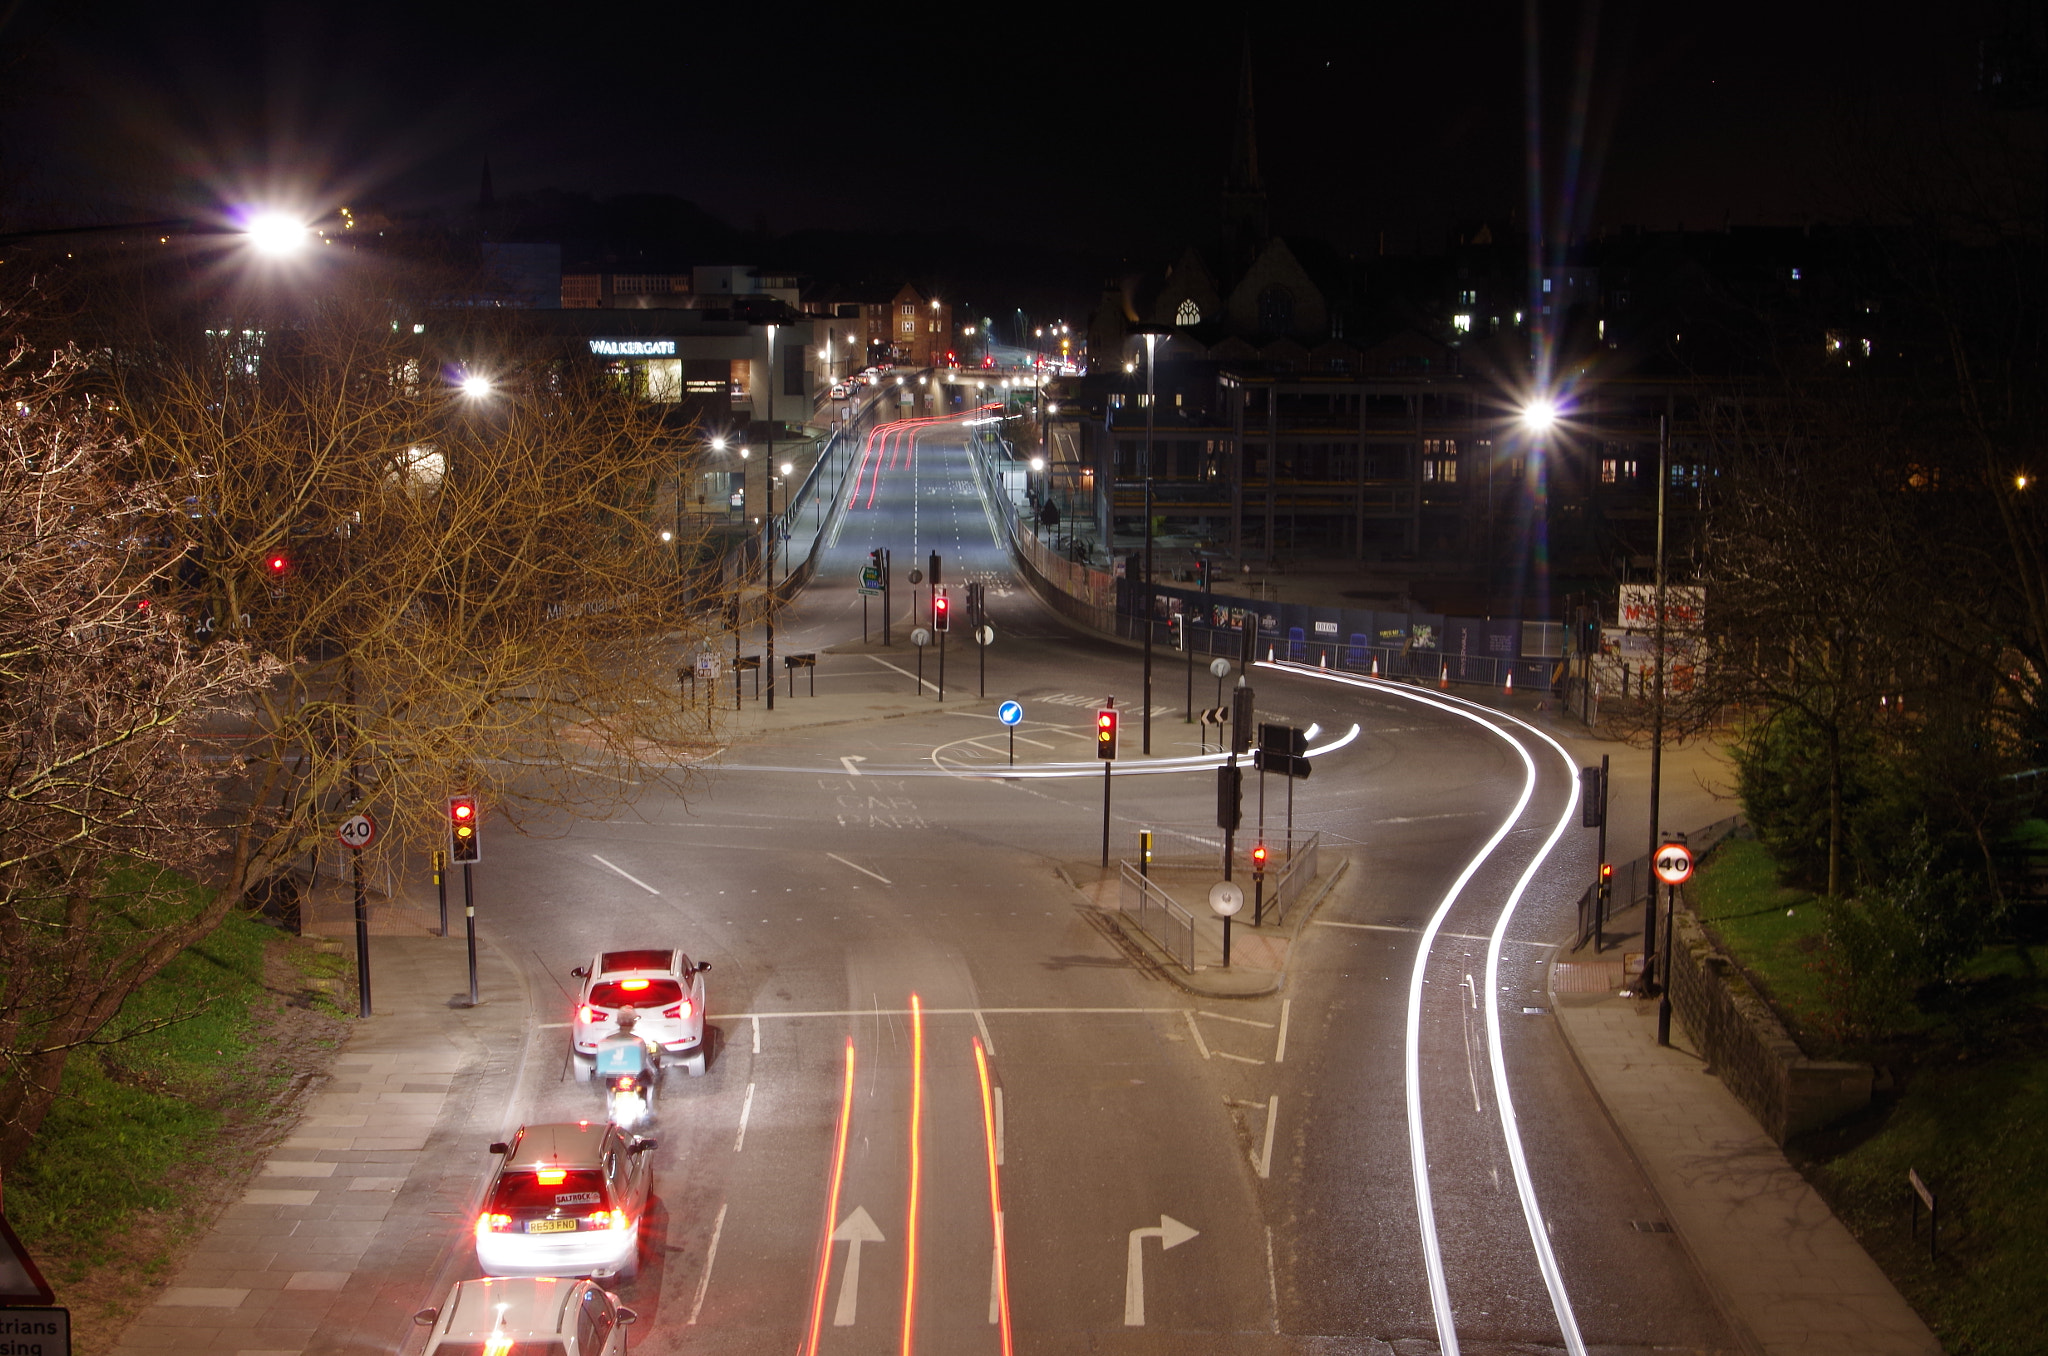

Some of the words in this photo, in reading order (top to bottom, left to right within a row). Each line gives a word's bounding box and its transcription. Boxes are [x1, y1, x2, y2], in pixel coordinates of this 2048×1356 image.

[589, 340, 676, 355] WALKERGATE
[1316, 623, 1337, 632] ODEON
[342, 822, 371, 838] 40
[1658, 856, 1688, 871] 40
[556, 1193, 591, 1203] SALTROCK
[530, 1221, 554, 1231] RE53
